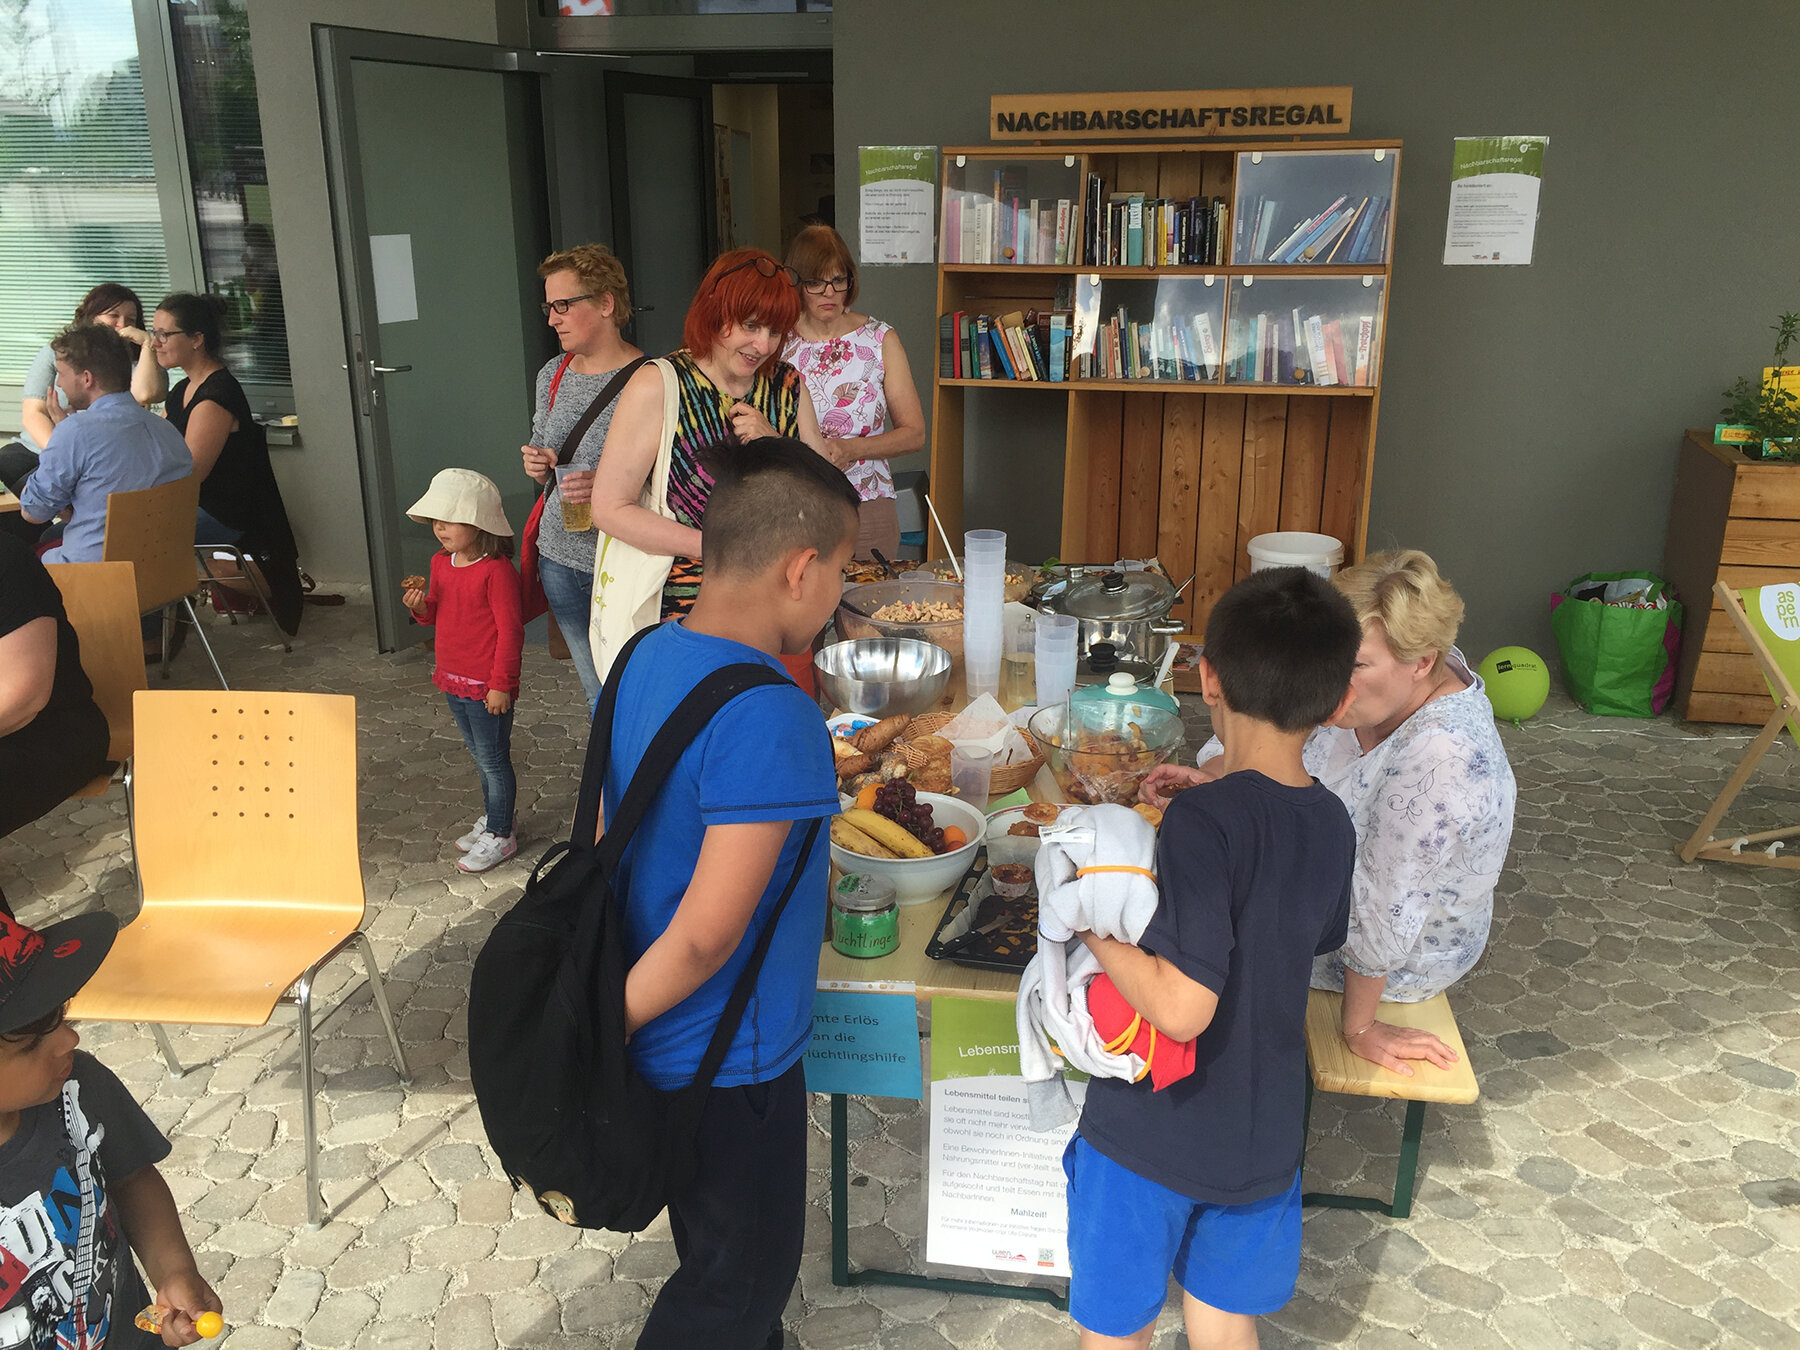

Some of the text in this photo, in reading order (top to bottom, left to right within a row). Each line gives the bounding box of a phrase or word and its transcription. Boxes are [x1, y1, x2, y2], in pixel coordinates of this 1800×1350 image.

[998, 104, 1342, 132] NACHBARSCHAFTSREGAL
[1777, 591, 1795, 603] as
[1776, 603, 1796, 620] pe
[812, 1014, 879, 1026] mte Erlös
[812, 1032, 856, 1042] an die
[803, 1049, 906, 1064] lüchtlingshilfe
[959, 1044, 1020, 1058] Lebensm
[944, 1088, 997, 1101] Lebensmittel
[999, 1095, 1021, 1103] teilen
[943, 1104, 993, 1116] Lebensmittel
[1011, 1112, 1029, 1120] kost
[968, 1119, 987, 1127] nicht
[988, 1120, 1009, 1129] mehr
[1010, 1122, 1030, 1131] verw
[943, 1126, 972, 1136] obwohl
[985, 1130, 1005, 1140] noch
[1006, 1132, 1013, 1140] in
[1015, 1133, 1049, 1146] Ordnung
[943, 1143, 960, 1152] Eine
[942, 1154, 1000, 1166] Nahrungsmittel
[1001, 1160, 1016, 1168] und
[942, 1169, 955, 1177] Für
[957, 1171, 971, 1179] den
[973, 1172, 1044, 1188] Nachbarschaftstag
[1046, 1180, 1058, 1188] hat
[942, 1180, 984, 1191] aufgekocht
[985, 1184, 1001, 1192] und
[1017, 1187, 1041, 1197] Essen
[1011, 1208, 1048, 1219] Mahlzeit!
